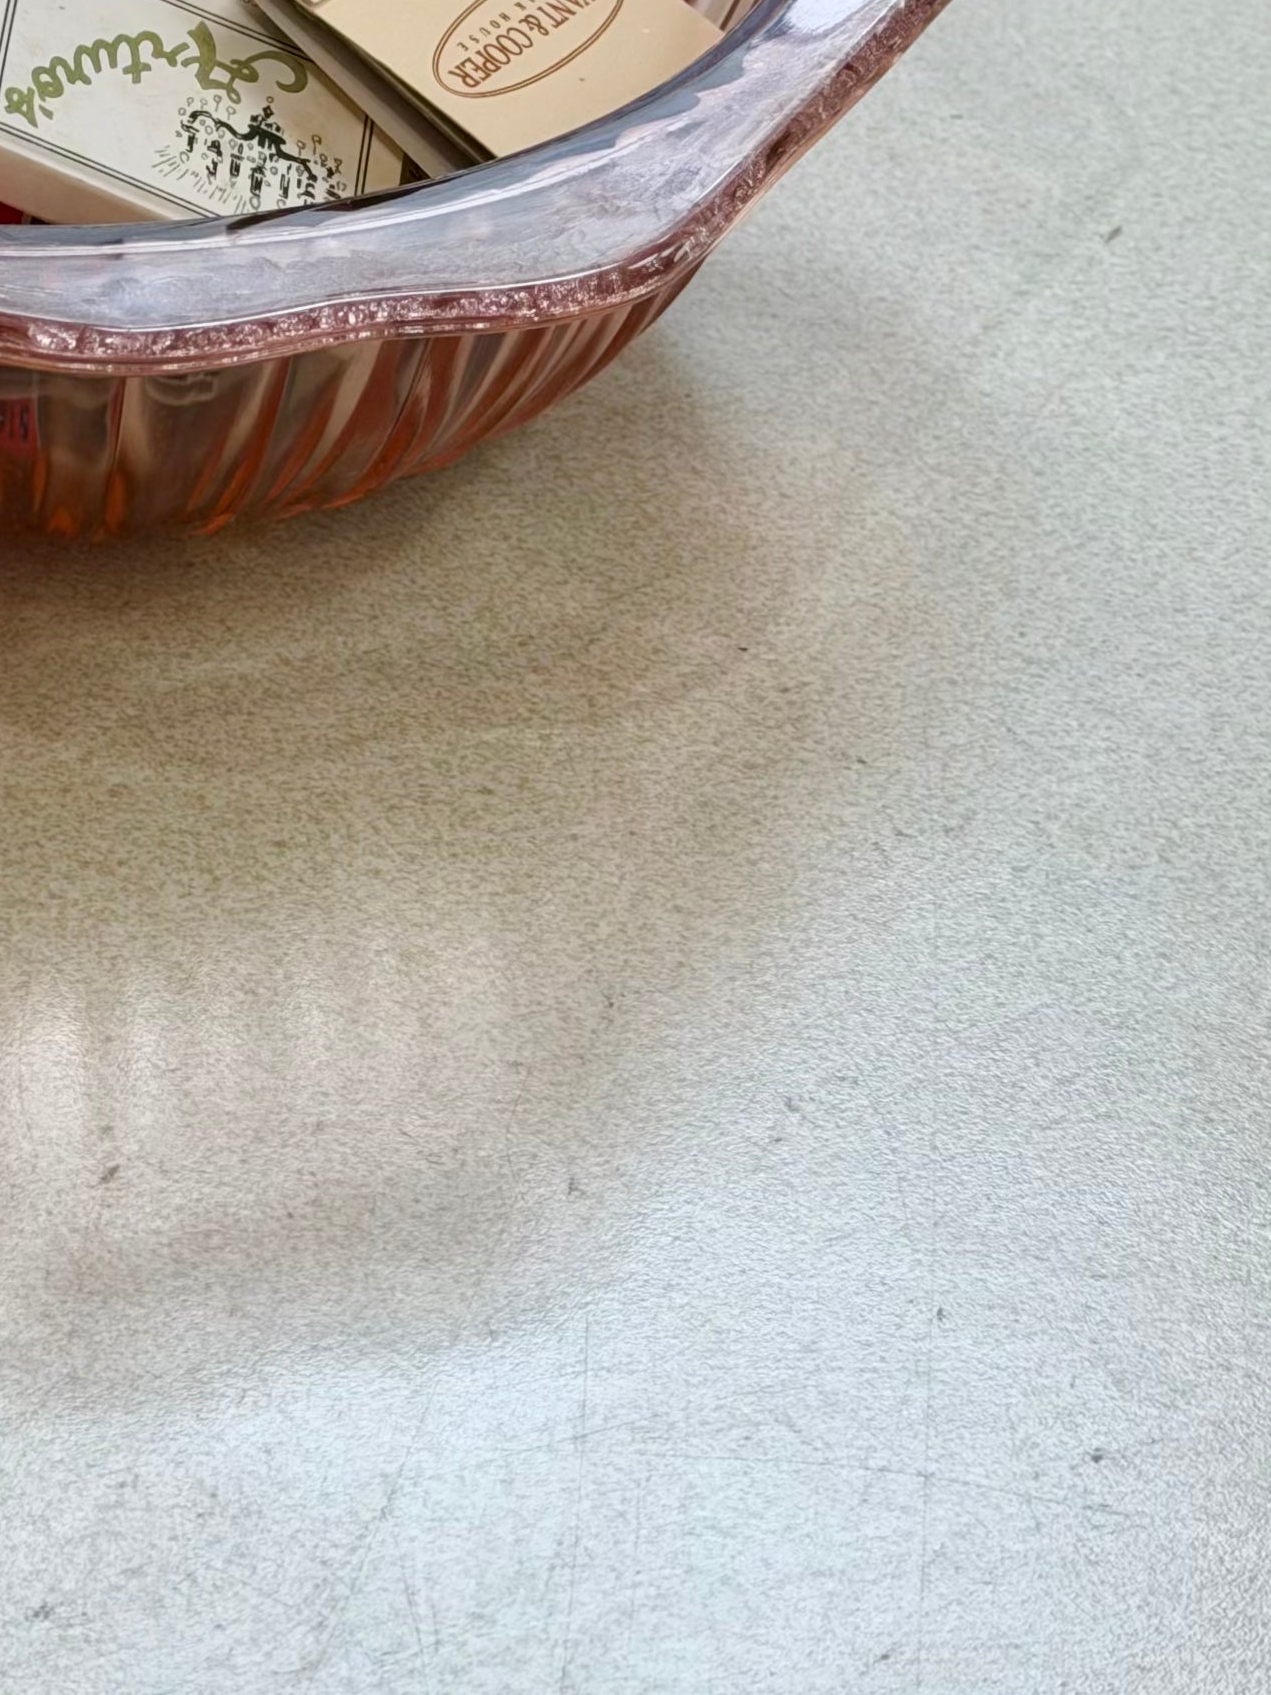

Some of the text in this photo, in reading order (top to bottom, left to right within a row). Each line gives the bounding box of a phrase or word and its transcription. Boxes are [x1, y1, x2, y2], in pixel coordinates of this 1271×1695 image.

[456, 11, 511, 53] HOUSE
[518, 14, 549, 37] &
[447, 26, 535, 89] COOPER
